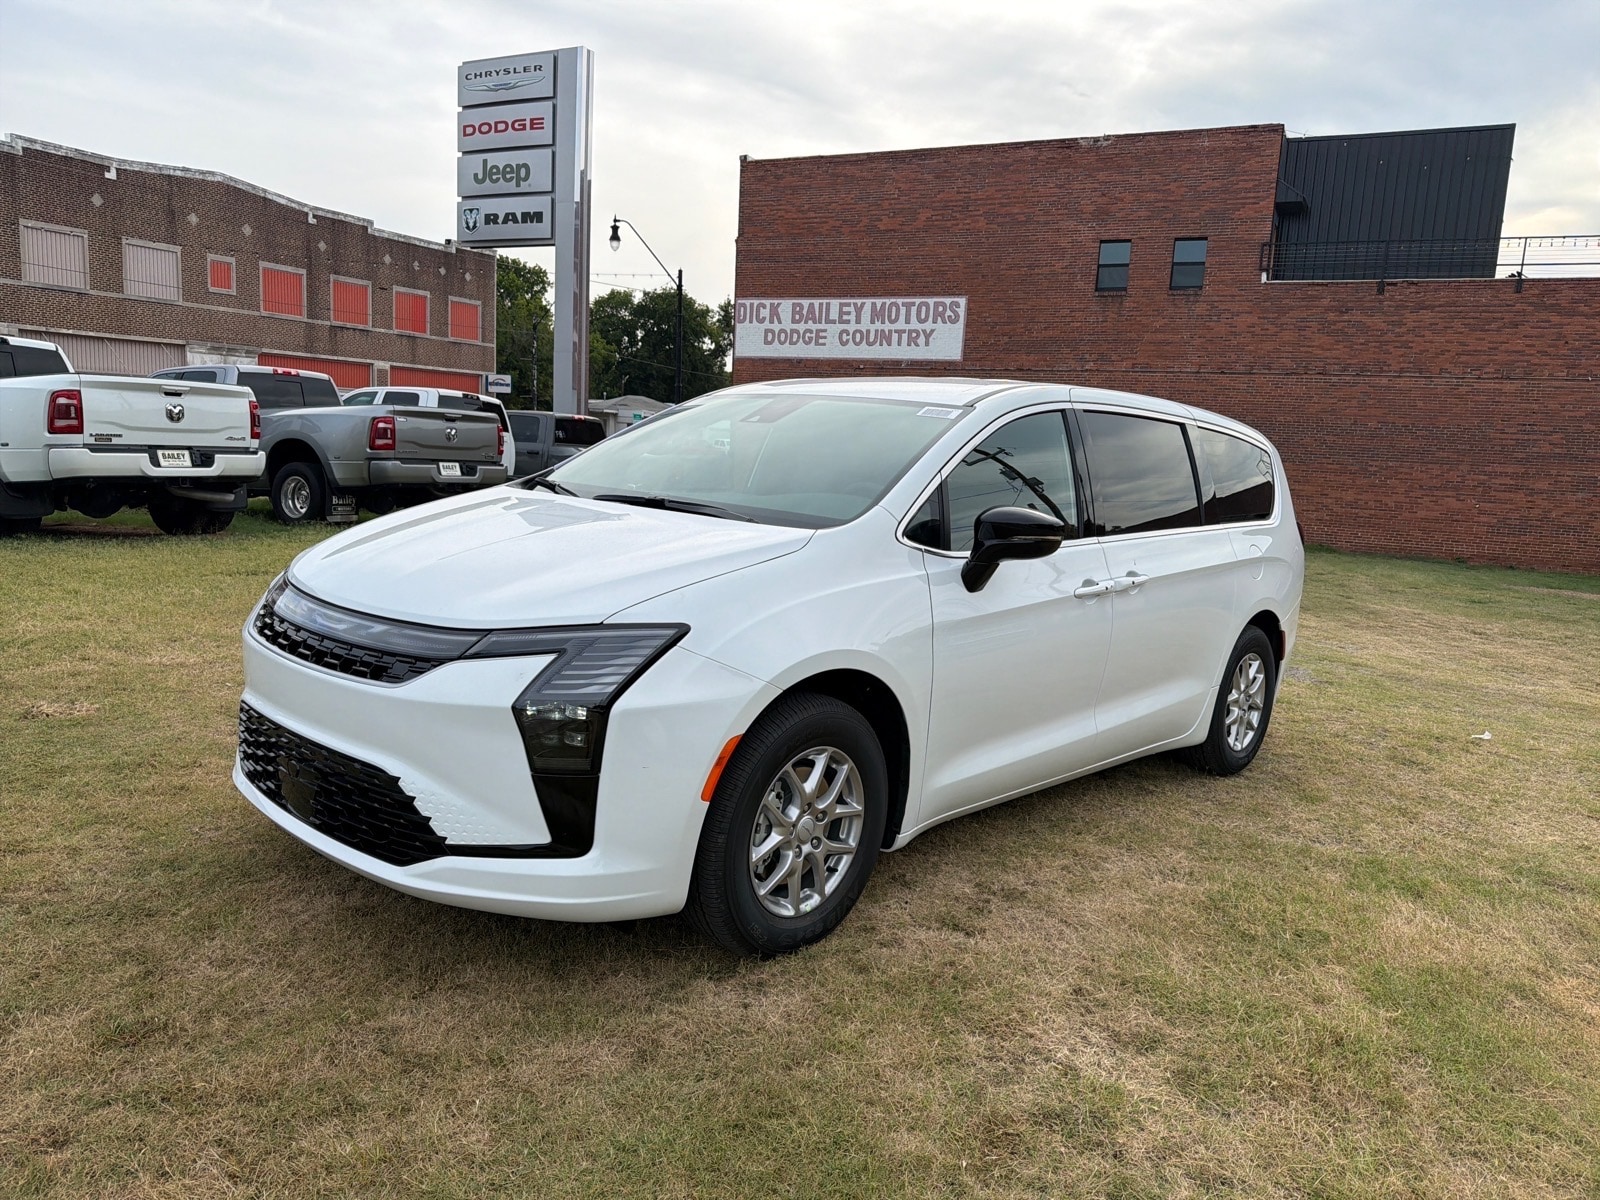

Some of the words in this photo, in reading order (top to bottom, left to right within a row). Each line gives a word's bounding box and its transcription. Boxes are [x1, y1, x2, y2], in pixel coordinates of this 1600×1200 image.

[465, 64, 544, 81] CHRYSLER
[462, 117, 545, 137] DODGE
[473, 158, 531, 187] Jeep
[484, 211, 544, 226] RAM
[736, 301, 782, 324] DICK
[791, 301, 866, 325] BAILEY
[869, 300, 961, 325] MOTORS
[763, 328, 828, 346] DODGE
[838, 328, 936, 347] COUNTRY
[161, 452, 186, 460] BAILEY
[332, 495, 357, 507] Bailey
